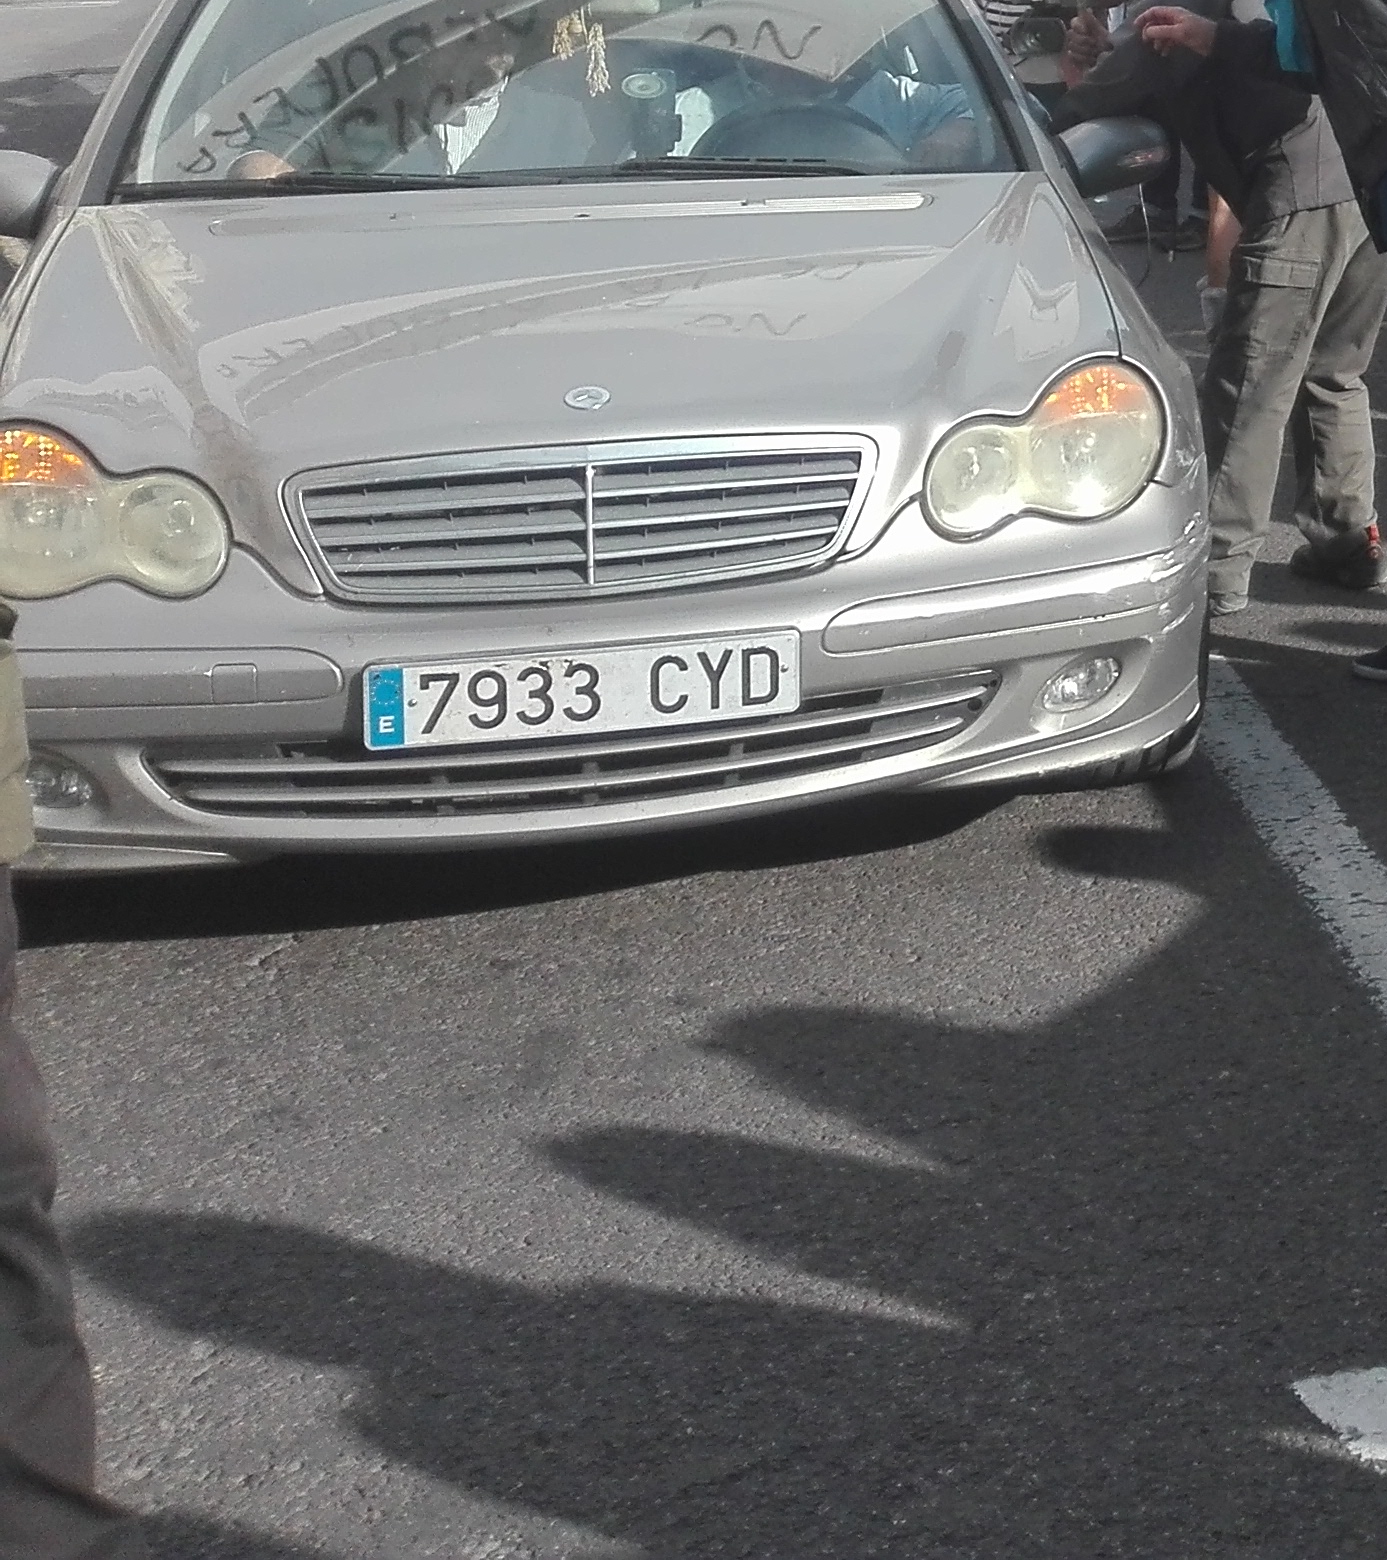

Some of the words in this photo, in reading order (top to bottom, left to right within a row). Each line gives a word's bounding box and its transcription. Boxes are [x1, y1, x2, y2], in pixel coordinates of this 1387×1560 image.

[379, 715, 395, 733] E
[418, 664, 602, 735] 7933
[649, 645, 781, 715] CYD
